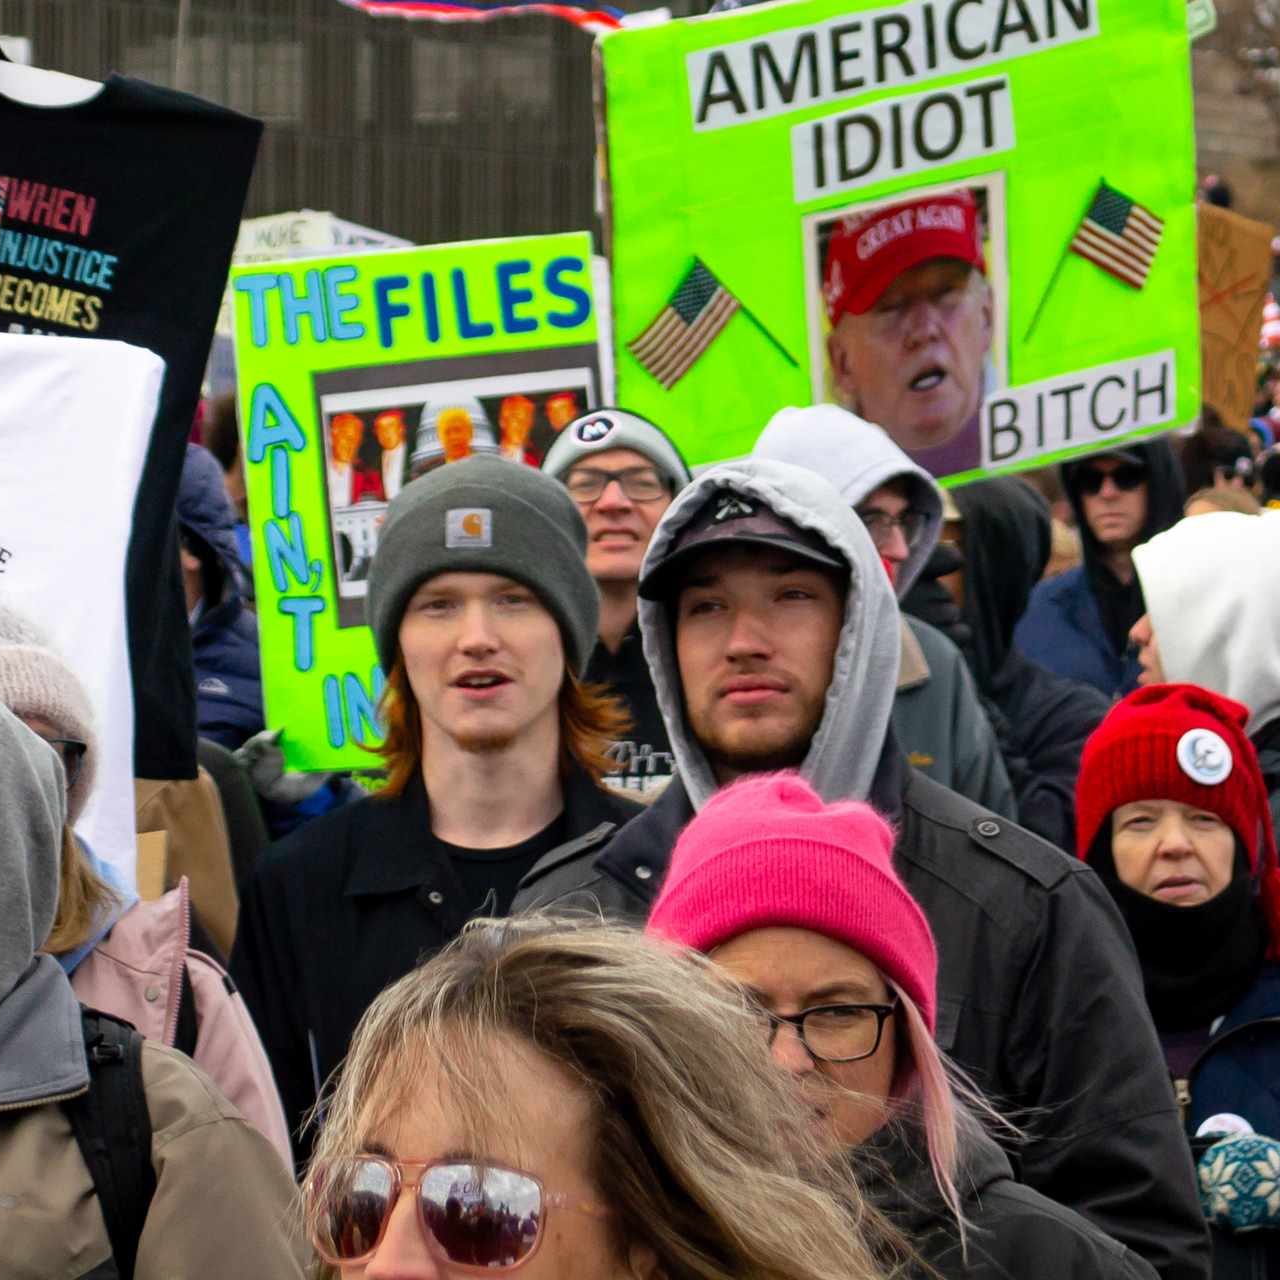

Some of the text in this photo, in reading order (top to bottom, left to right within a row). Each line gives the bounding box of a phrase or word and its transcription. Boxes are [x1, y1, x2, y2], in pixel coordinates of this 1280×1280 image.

[813, 80, 1008, 189] IDIOT
[6, 177, 97, 238] WHEN
[233, 256, 591, 348] THE FILES
[988, 362, 1169, 464] BITCH
